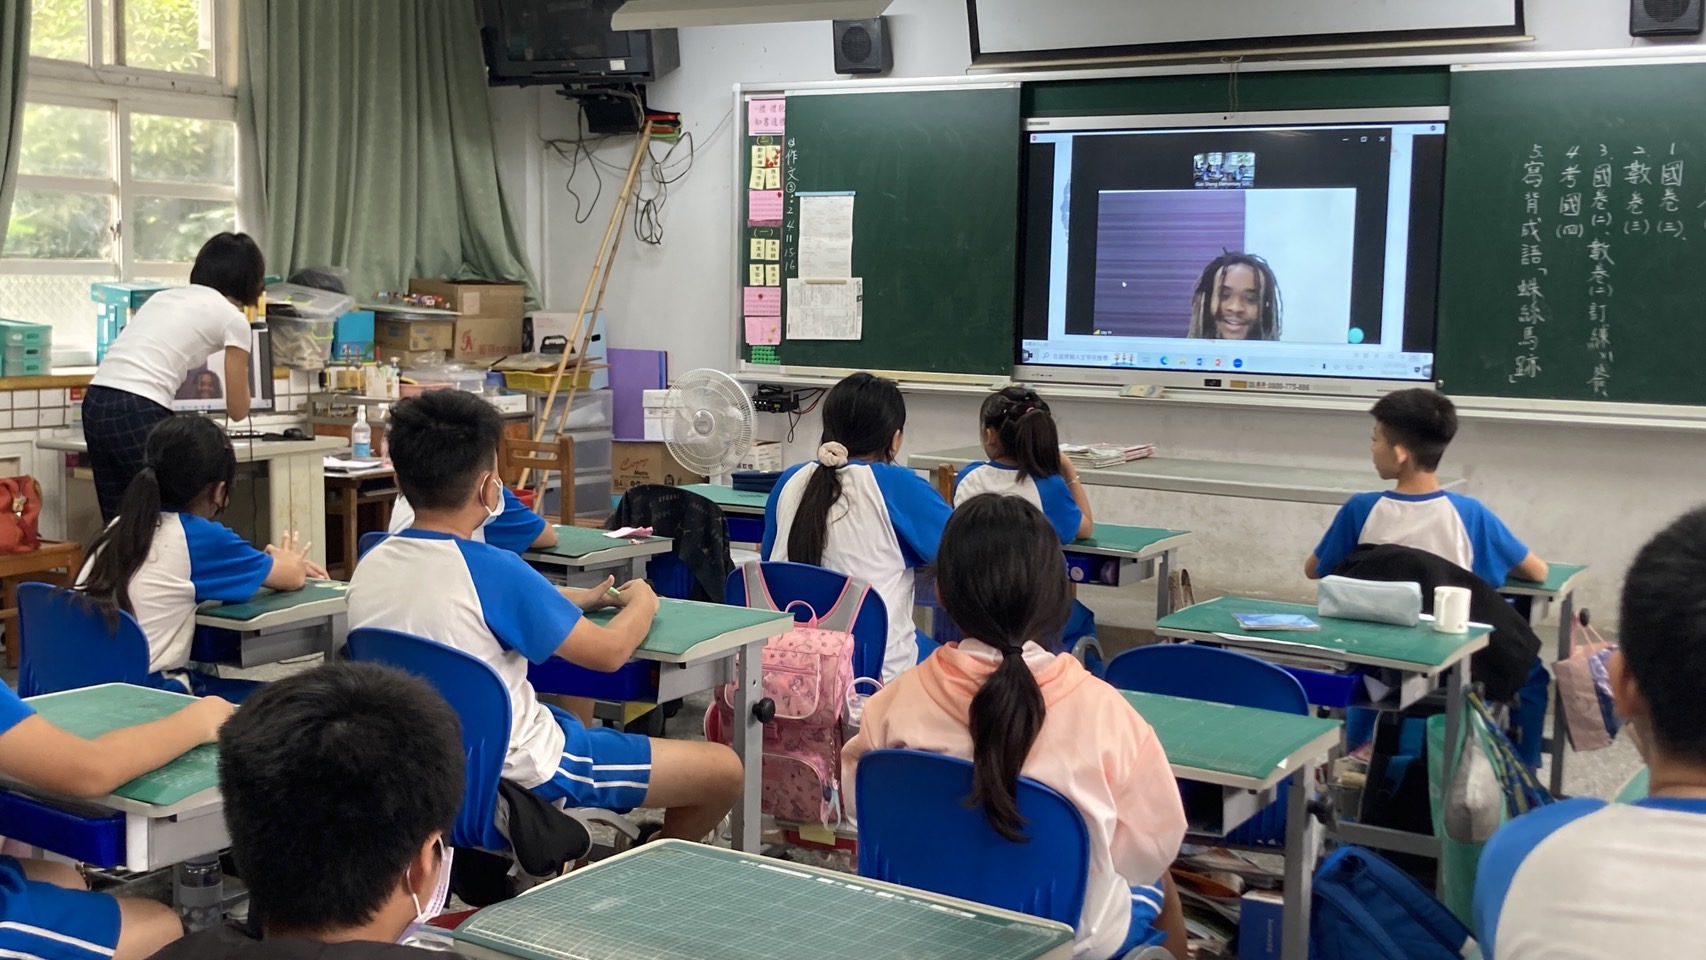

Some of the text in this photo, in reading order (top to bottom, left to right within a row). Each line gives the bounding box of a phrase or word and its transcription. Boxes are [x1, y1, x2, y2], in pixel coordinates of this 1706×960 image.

[786, 206, 794, 214] 2
[786, 219, 796, 232] 4
[785, 234, 793, 243] 11
[784, 259, 796, 272] 16
